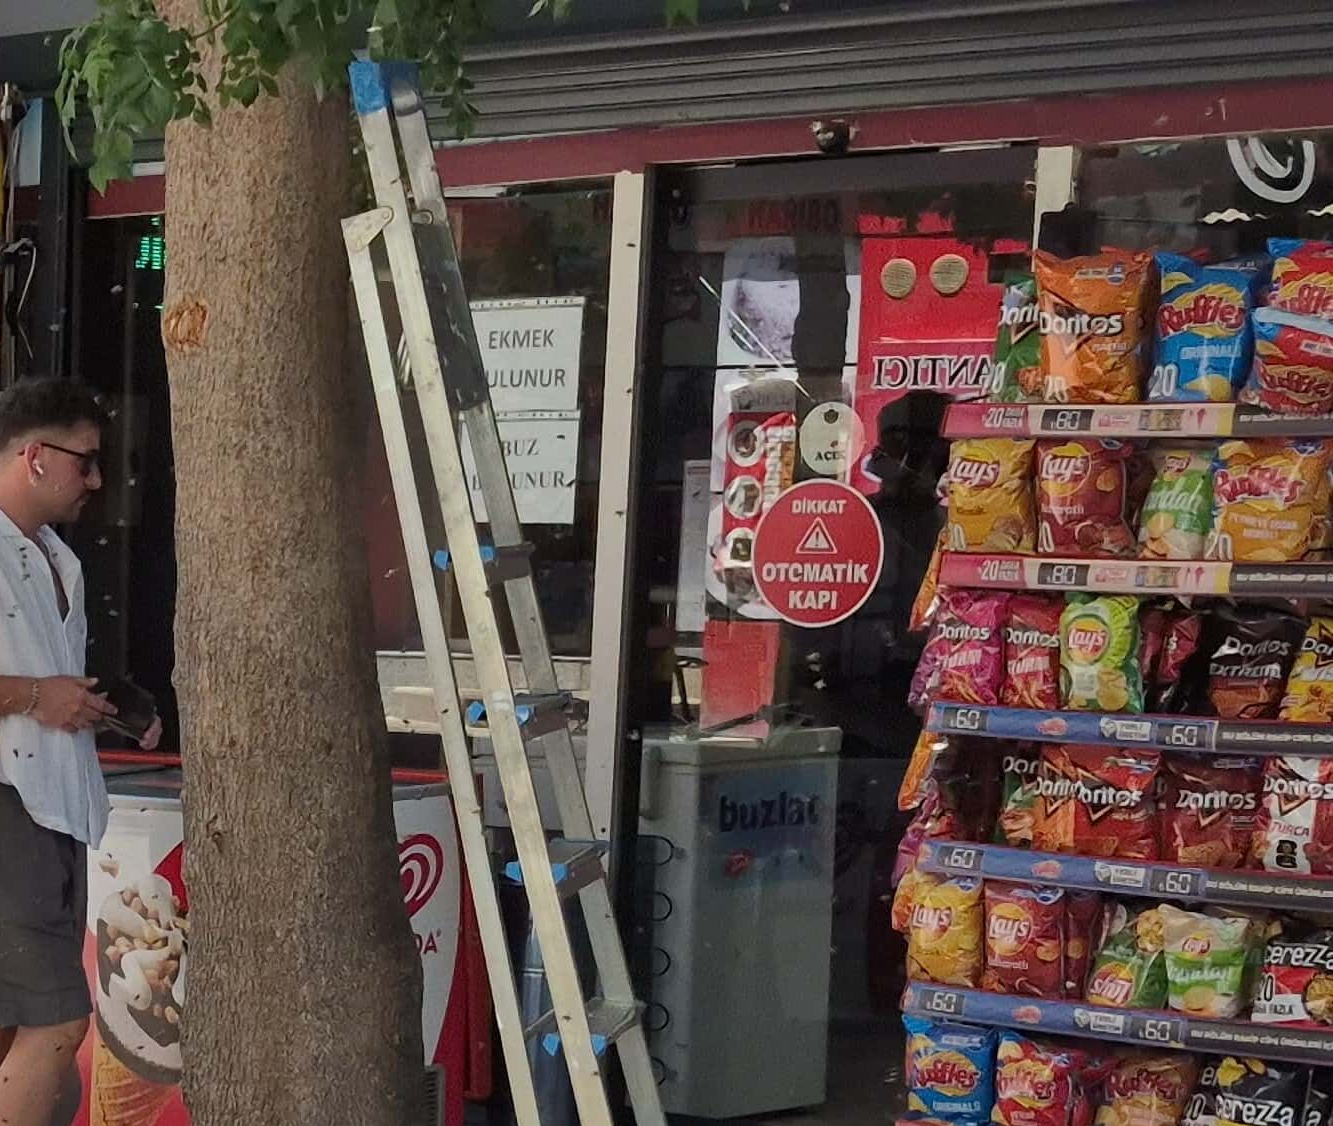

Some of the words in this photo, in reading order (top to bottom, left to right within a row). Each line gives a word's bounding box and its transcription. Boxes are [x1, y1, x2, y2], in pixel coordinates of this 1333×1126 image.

[1039, 313, 1123, 336] Doritos
[488, 329, 555, 350] EKMEK
[484, 368, 566, 389] ULUNUR
[1149, 363, 1179, 398] 20
[984, 407, 1004, 428] 20
[501, 439, 539, 457] BUZ
[791, 498, 847, 515] DİKKAT
[762, 559, 870, 584] OTOMATİK
[981, 560, 998, 581] 20
[788, 590, 839, 610] KAPI
[1176, 788, 1256, 810] Doritos
